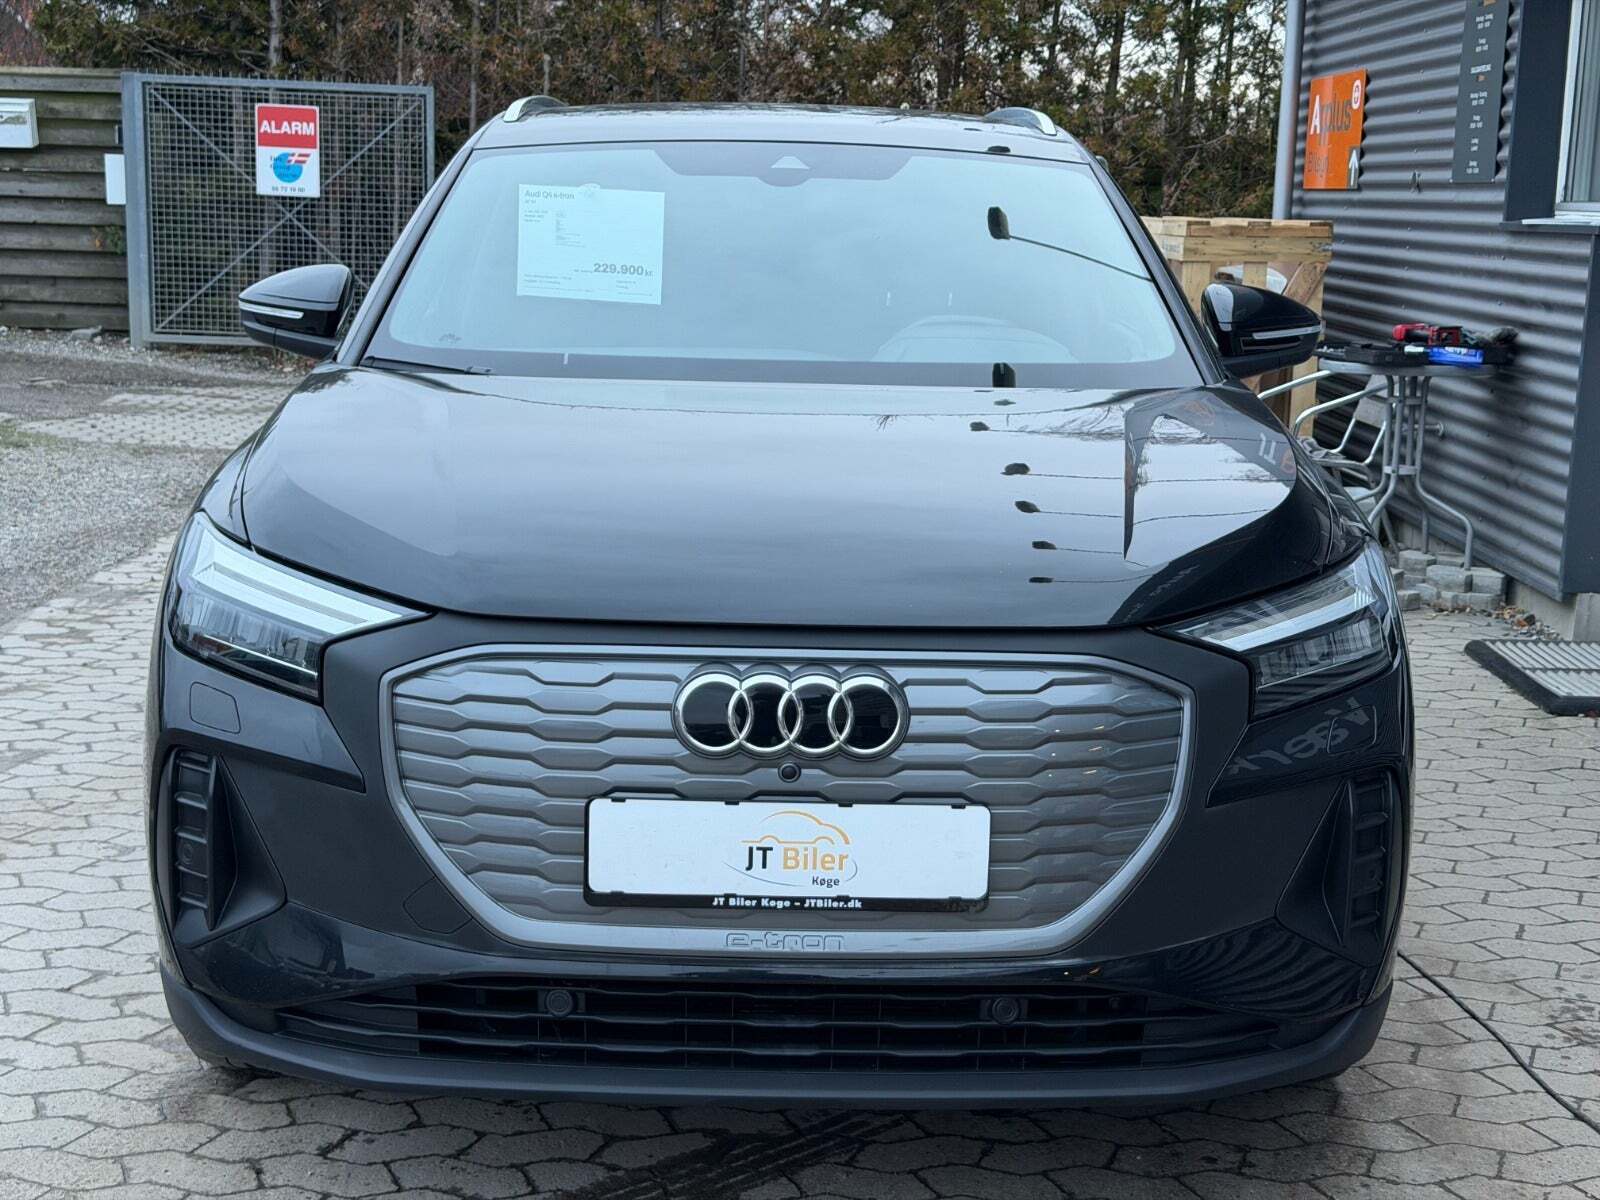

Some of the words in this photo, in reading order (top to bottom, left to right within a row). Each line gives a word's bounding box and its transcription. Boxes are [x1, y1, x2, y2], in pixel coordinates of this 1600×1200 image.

[260, 120, 315, 136] ALARM
[524, 190, 542, 198] Audi
[593, 262, 644, 276] 229.900
[745, 846, 773, 871] JT
[782, 846, 849, 871] Biler
[812, 875, 840, 889] Køge
[712, 896, 725, 906] JT
[729, 897, 757, 907] Biler
[804, 898, 862, 908] JTBiler.dk
[725, 931, 845, 952] e-tron
